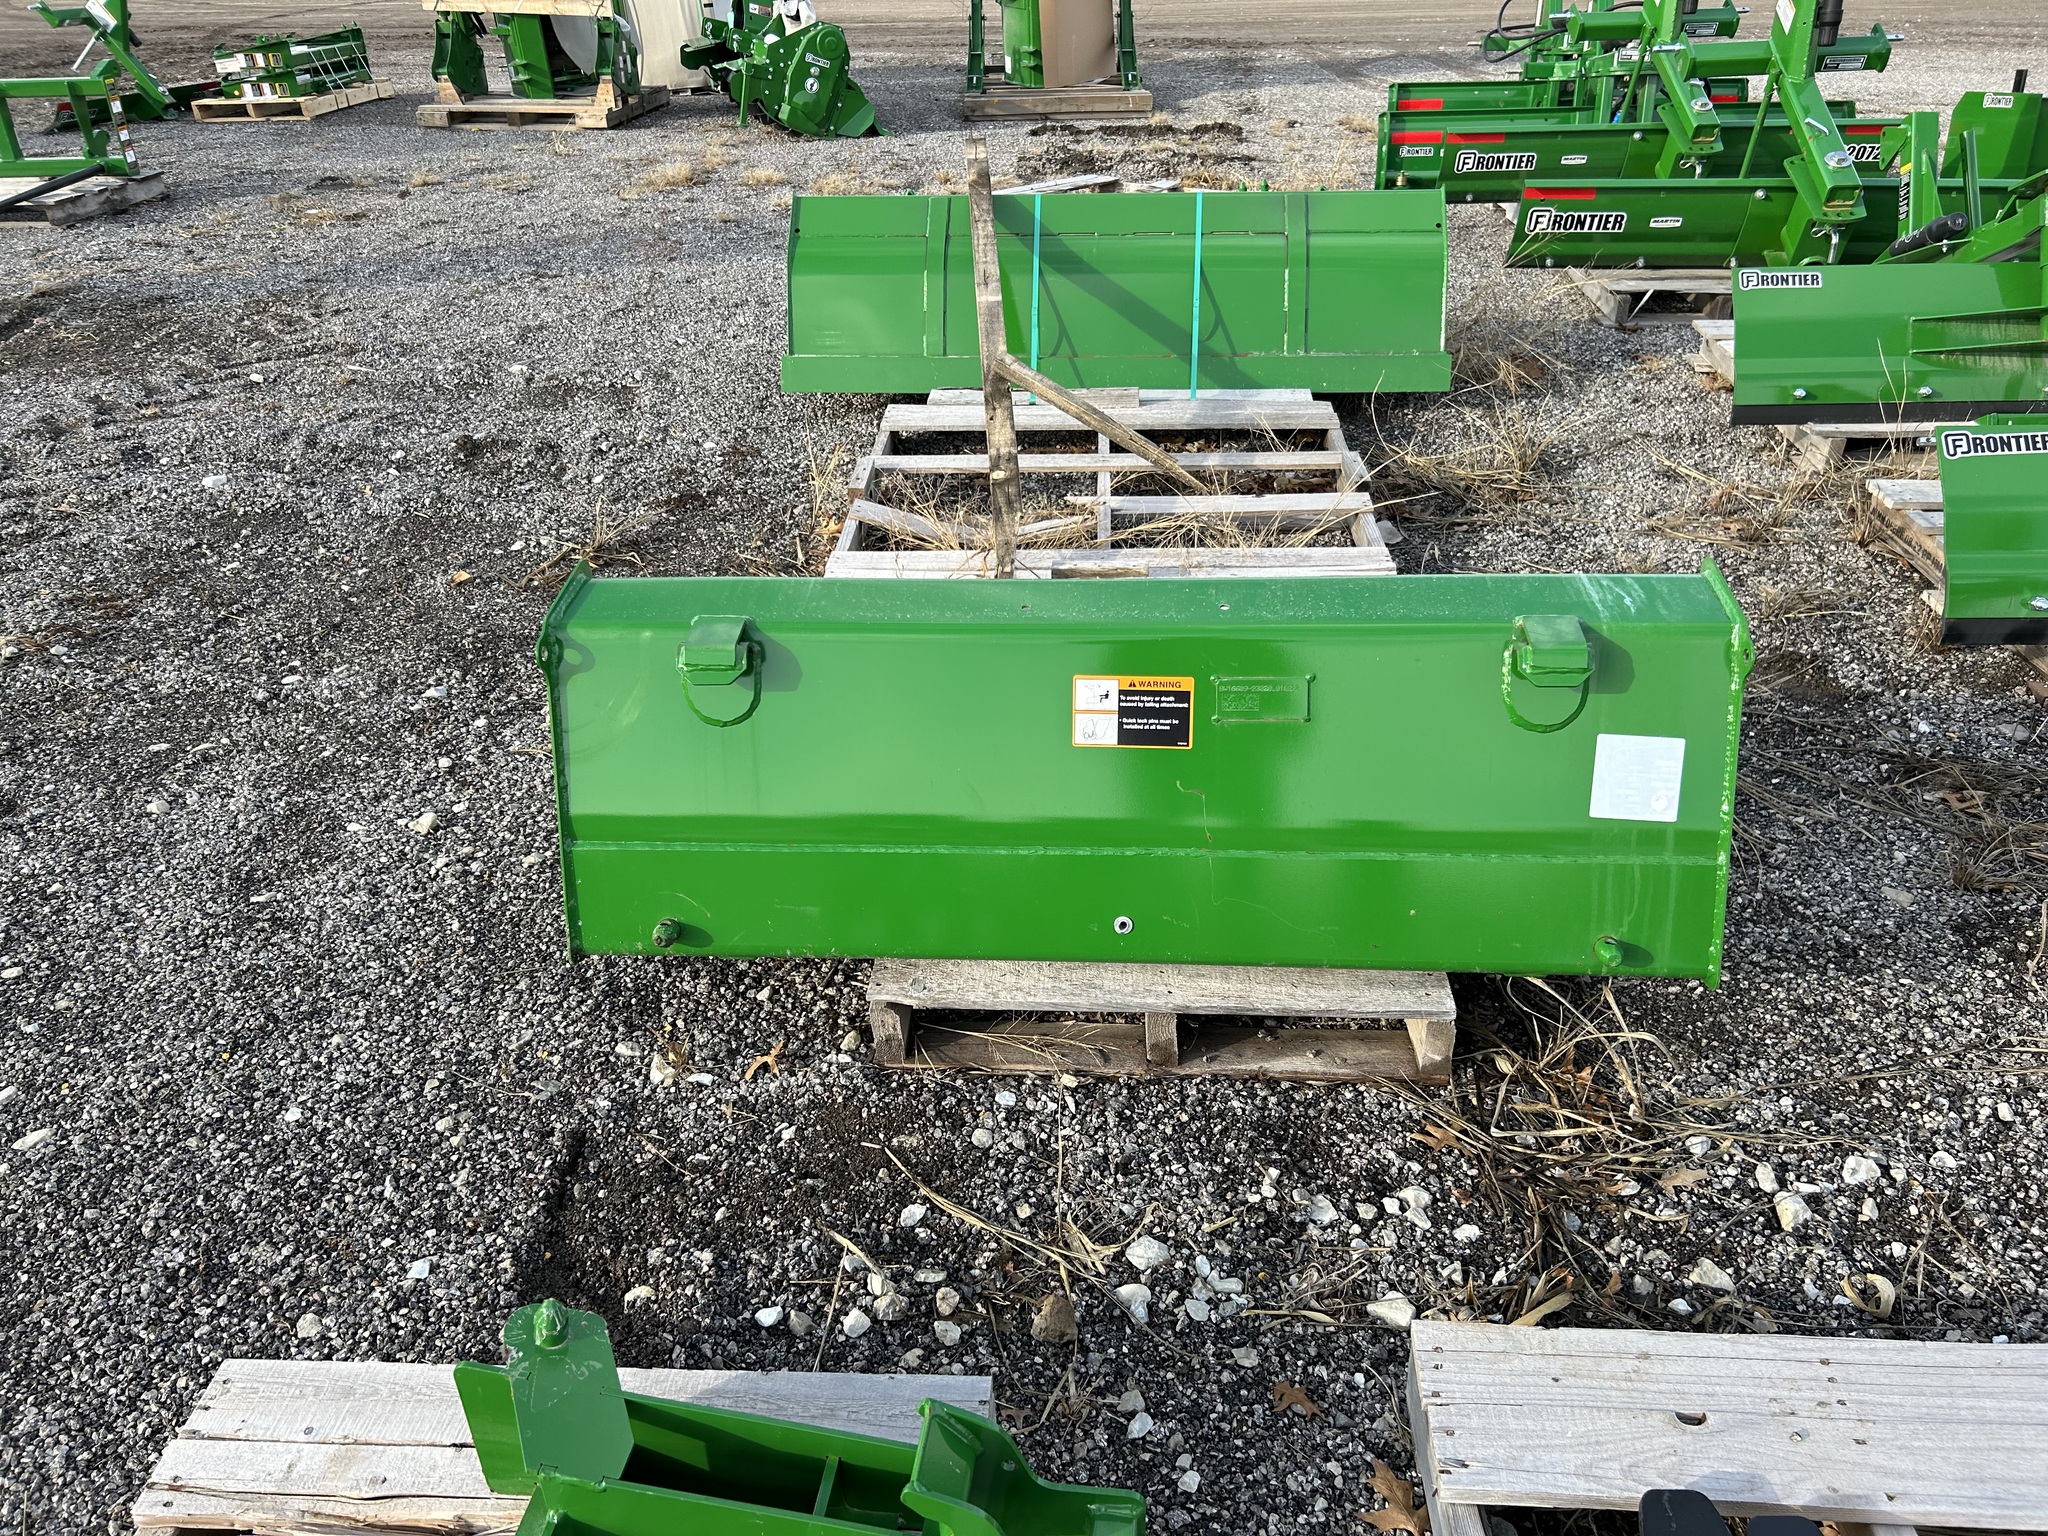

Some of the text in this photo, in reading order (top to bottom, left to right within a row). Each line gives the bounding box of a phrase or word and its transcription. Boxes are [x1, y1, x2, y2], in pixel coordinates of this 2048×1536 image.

[1984, 94, 2013, 107] FRONTIER
[1400, 147, 1433, 156] FRONTIER
[1456, 152, 1536, 172] FRONTIER
[1527, 209, 1625, 232] FRONTIER
[1741, 271, 1820, 288] FRONTIER
[1138, 680, 1182, 689] WARNING
